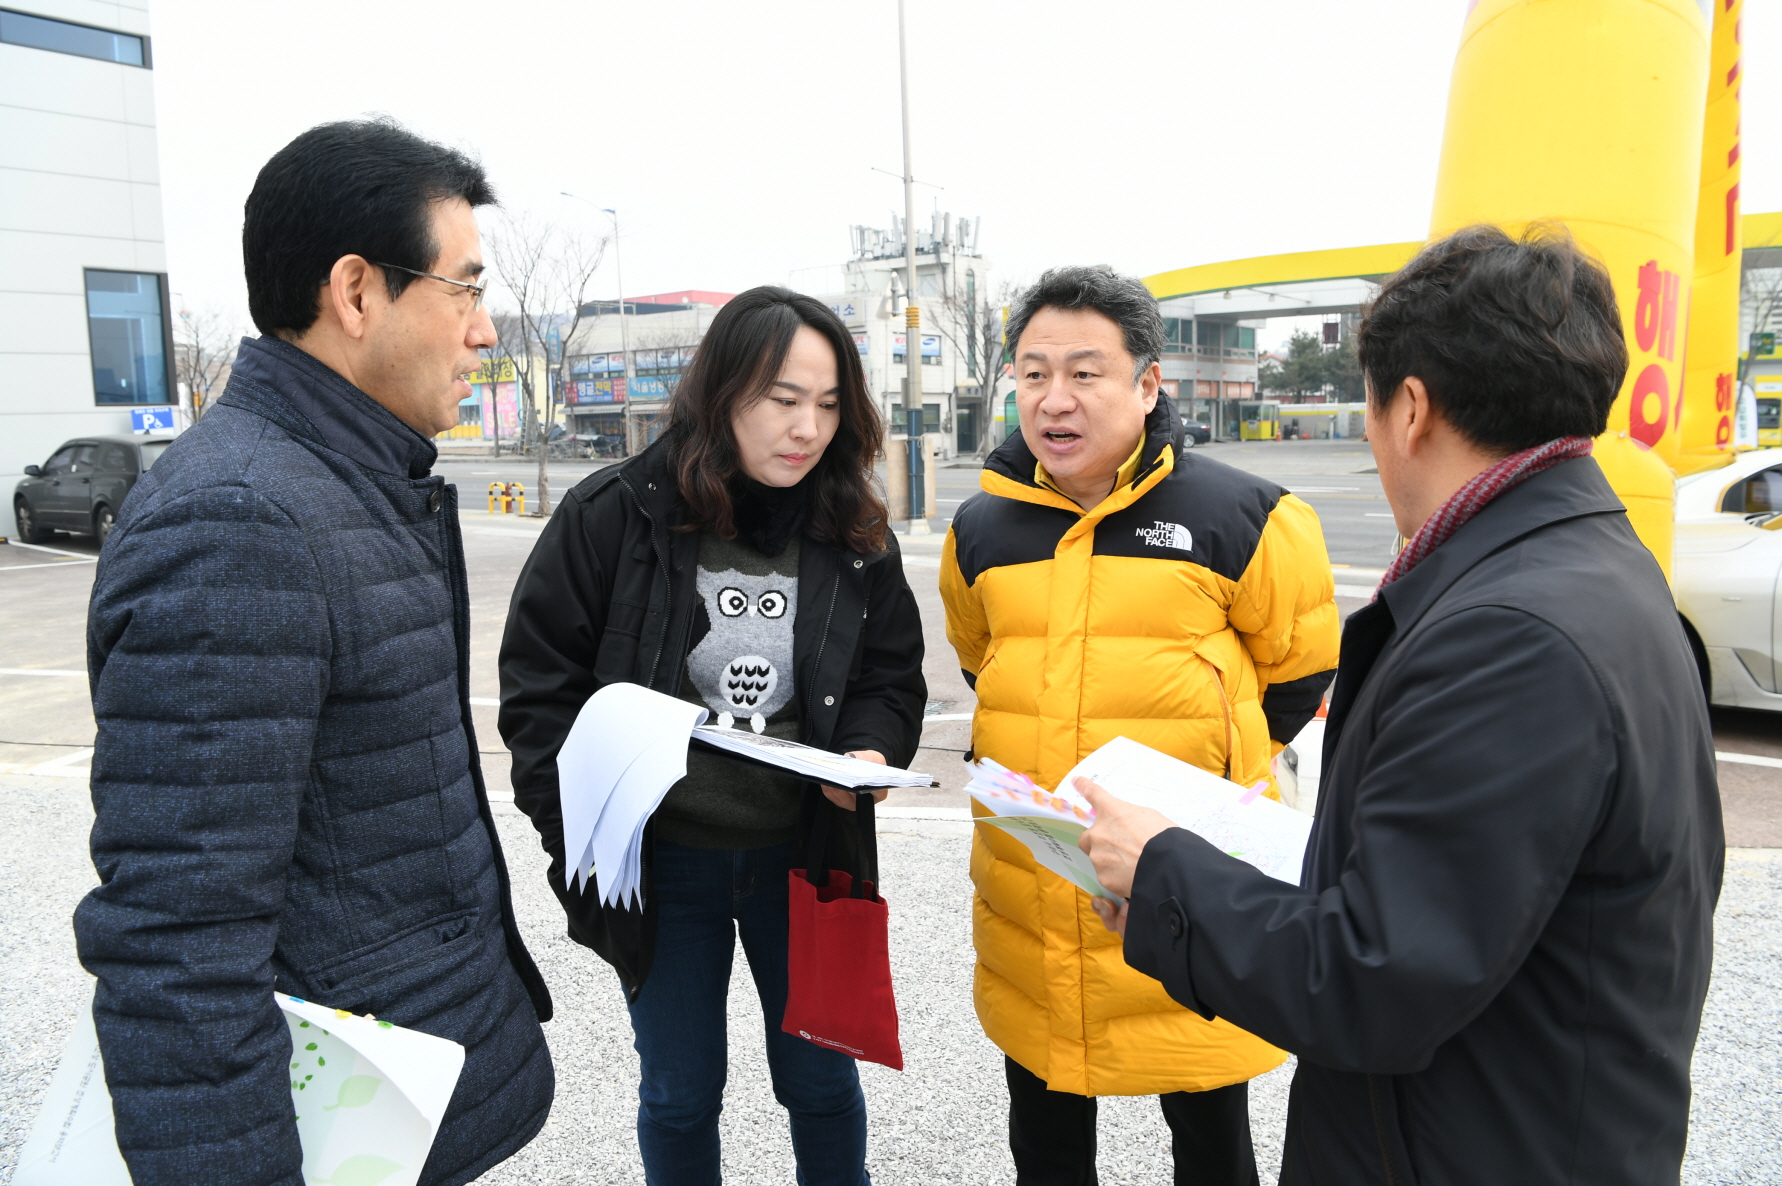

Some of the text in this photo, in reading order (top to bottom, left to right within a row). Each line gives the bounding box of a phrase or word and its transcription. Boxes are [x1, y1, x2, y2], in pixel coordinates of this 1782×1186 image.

[1629, 259, 1686, 452] 행
[142, 413, 155, 430] P
[1153, 520, 1175, 531] THE
[1135, 527, 1174, 540] NORTH
[1145, 537, 1173, 548] FACE
